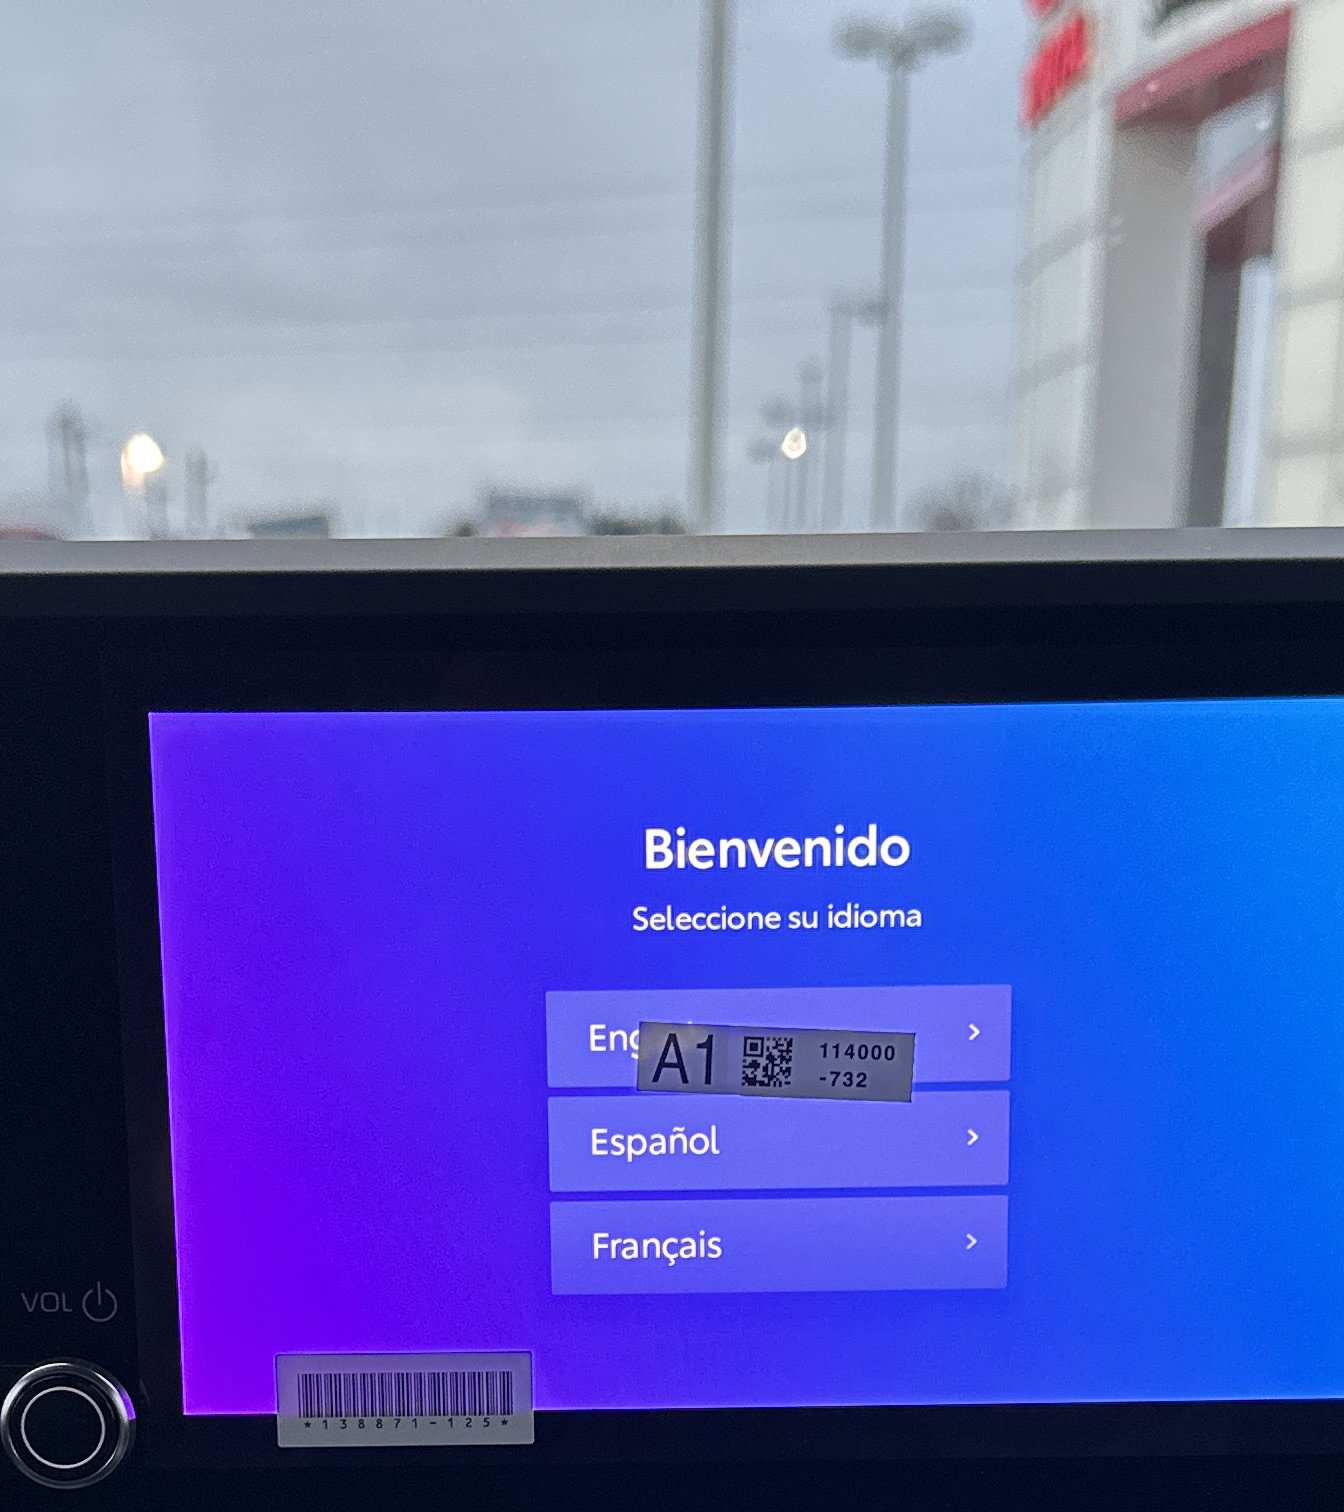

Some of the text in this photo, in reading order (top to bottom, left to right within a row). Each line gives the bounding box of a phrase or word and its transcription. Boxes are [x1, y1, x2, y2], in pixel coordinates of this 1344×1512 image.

[645, 823, 910, 870] Bienvenido
[632, 902, 922, 931] Seleccione su idioma
[652, 1033, 714, 1085] A1
[819, 1042, 896, 1061] 114000
[819, 1071, 867, 1089] -732
[591, 1125, 720, 1162] Español
[593, 1230, 723, 1266] Français
[20, 1292, 73, 1312] VOL
